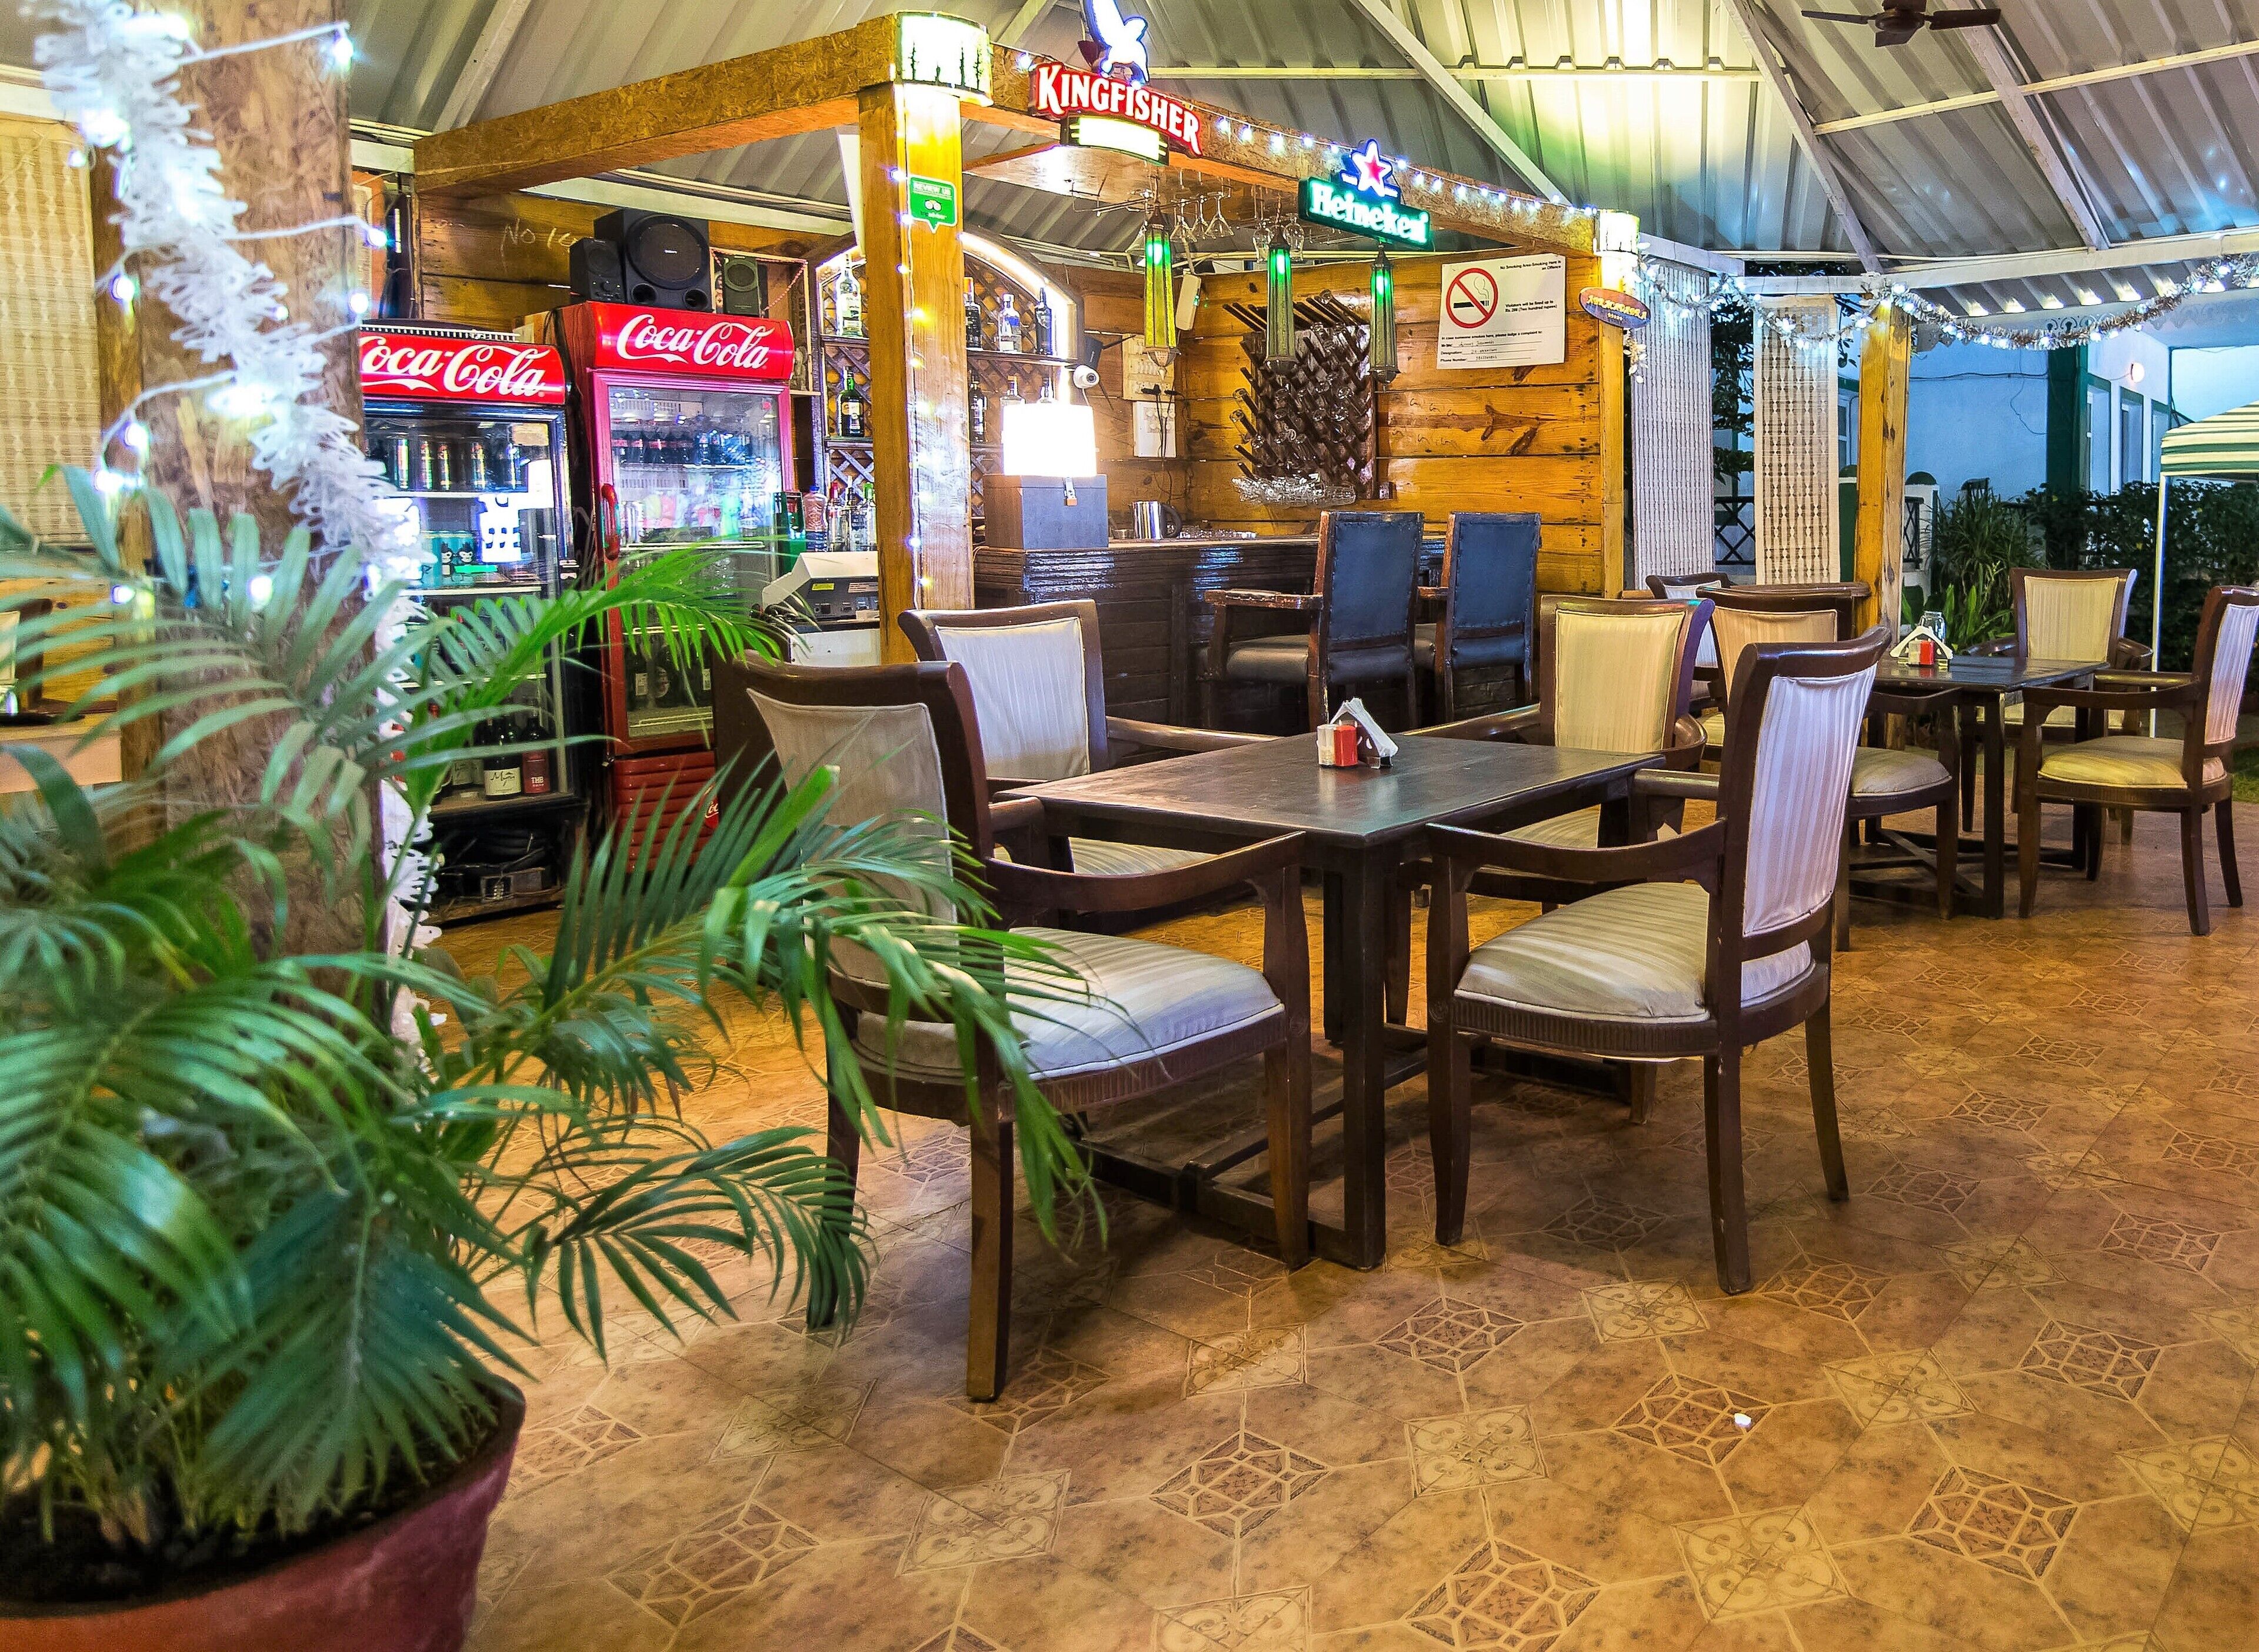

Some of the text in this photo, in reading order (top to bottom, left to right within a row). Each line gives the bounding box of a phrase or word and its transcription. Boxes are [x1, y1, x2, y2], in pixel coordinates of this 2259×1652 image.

[1037, 64, 1204, 156] KINGFISHER
[1310, 181, 1430, 243] Heineken
[616, 313, 776, 369] Coca-Cola
